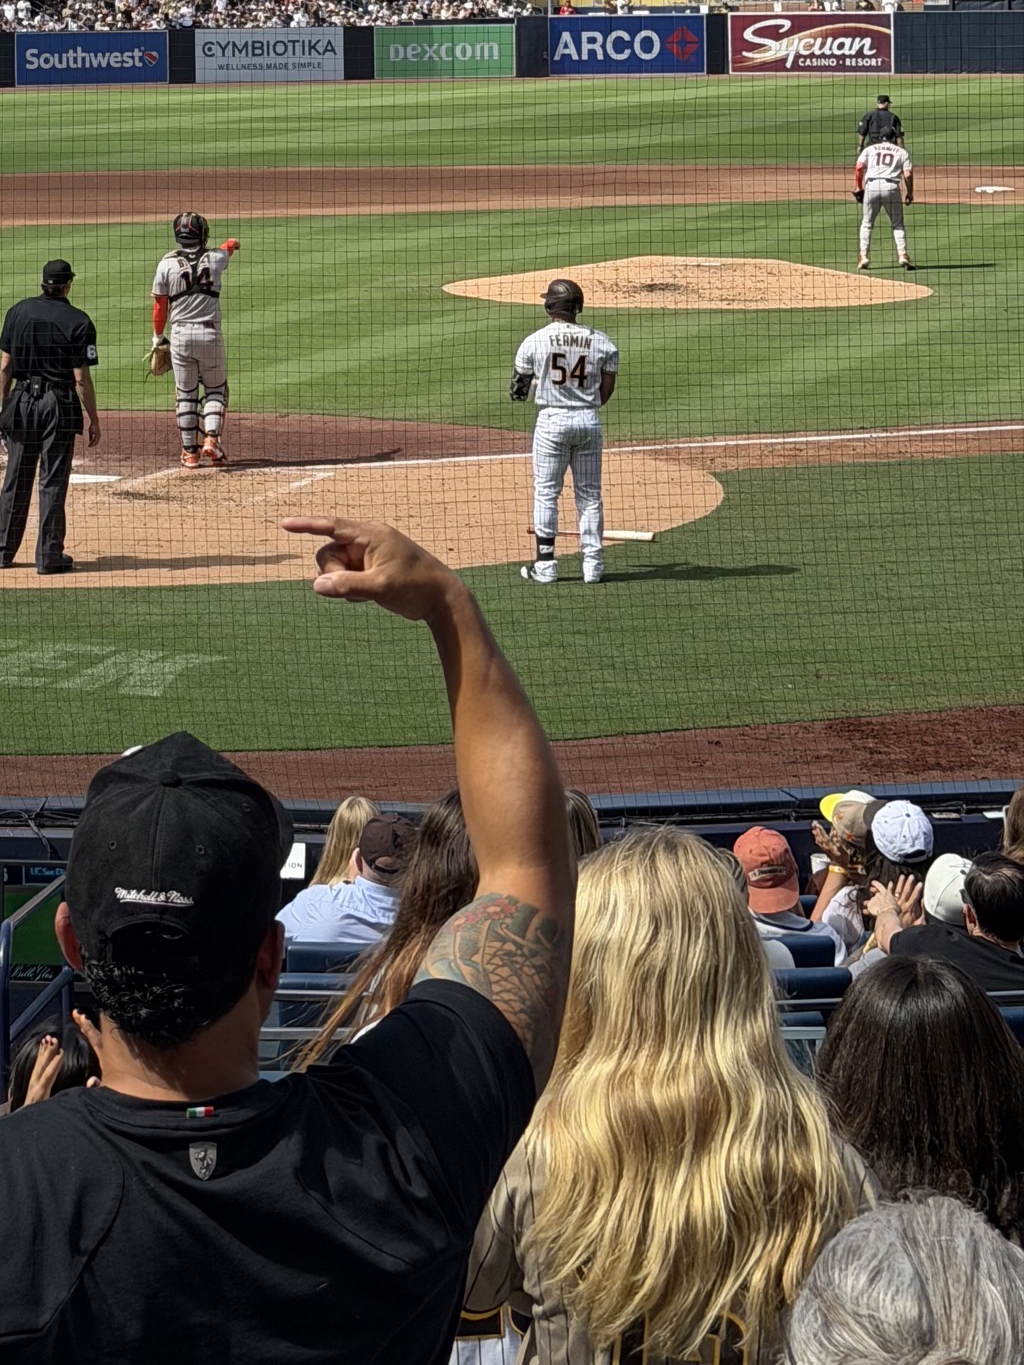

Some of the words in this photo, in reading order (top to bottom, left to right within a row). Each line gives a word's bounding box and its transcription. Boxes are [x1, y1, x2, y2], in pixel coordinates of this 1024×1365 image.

[202, 39, 337, 58] CYMBIOTIKA
[553, 29, 660, 61] ARCO
[742, 18, 877, 69] Sycuan
[25, 46, 143, 70] Southwest
[218, 63, 263, 72] WELLNESS
[266, 62, 290, 71] MADE
[291, 61, 323, 70] SIMPLE
[798, 57, 837, 68] CASINO
[845, 56, 883, 67] RESORT
[875, 152, 895, 167] 10
[549, 335, 592, 350] FERMIN
[551, 352, 587, 387] 54
[157, 892, 166, 902] &
